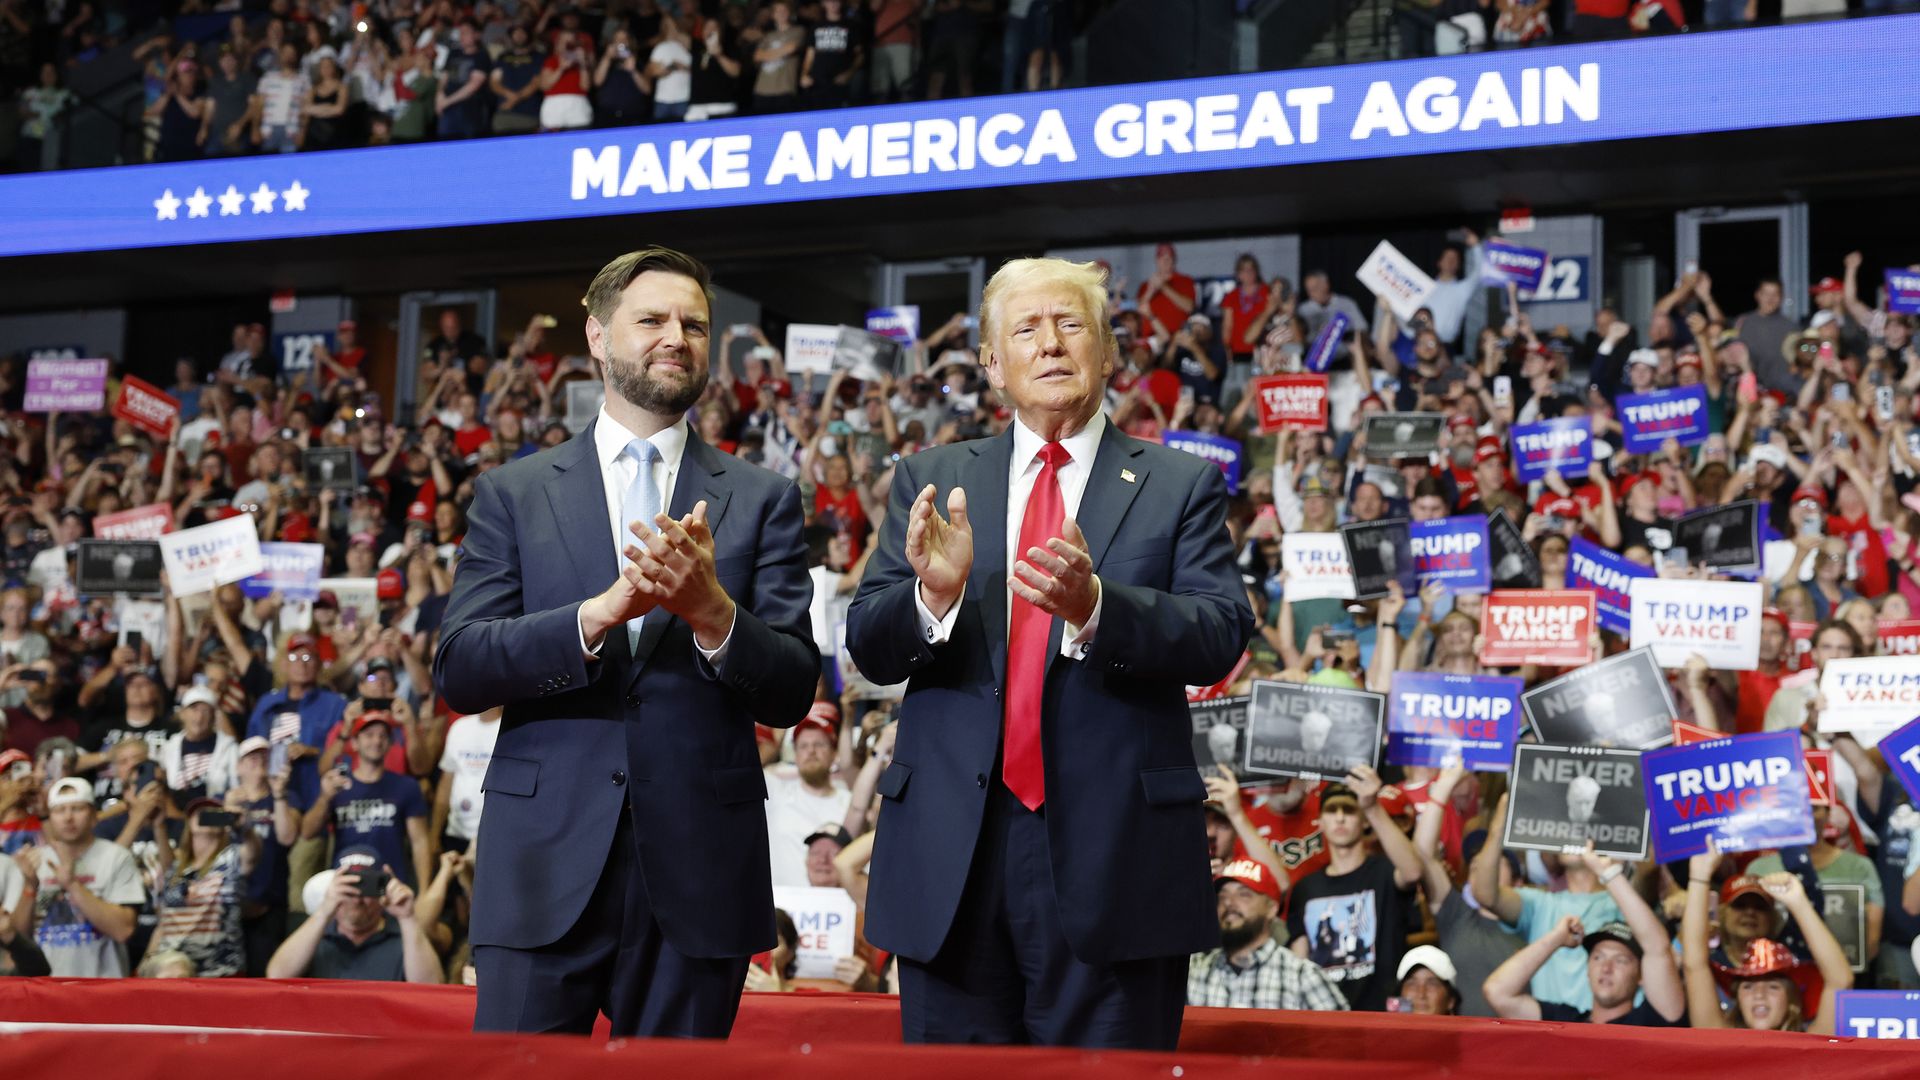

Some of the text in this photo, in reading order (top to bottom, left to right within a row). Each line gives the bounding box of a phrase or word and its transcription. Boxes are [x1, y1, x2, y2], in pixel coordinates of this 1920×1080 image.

[571, 62, 1599, 200] MAKE AMERICA GREAT AGAIN
[1489, 249, 1542, 270] TRUMP
[51, 378, 79, 391] For
[1262, 386, 1325, 401] TRUMP
[1269, 401, 1320, 415] VANCE
[1624, 397, 1701, 424] TRUMP
[1516, 428, 1588, 452] TRUMP
[103, 514, 167, 538] TRUMP
[1296, 550, 1350, 563] TRU
[1410, 532, 1481, 557] RUMP
[1572, 552, 1631, 595] TRUM
[1489, 605, 1587, 625] TRUMP
[1646, 601, 1749, 622] TRUMP
[1498, 624, 1577, 641] VANCE
[1656, 622, 1737, 641] VANCE
[1542, 664, 1641, 719] NEVER
[1267, 692, 1365, 723] NEVER
[1400, 692, 1512, 721] TRUMP
[1410, 716, 1498, 740] VANCE
[1532, 757, 1636, 788] NEVER
[1654, 756, 1792, 801] TRUMP
[335, 803, 397, 820] TRUMP
[1673, 785, 1781, 821] VANCE
[1514, 817, 1641, 845] SURRENDER
